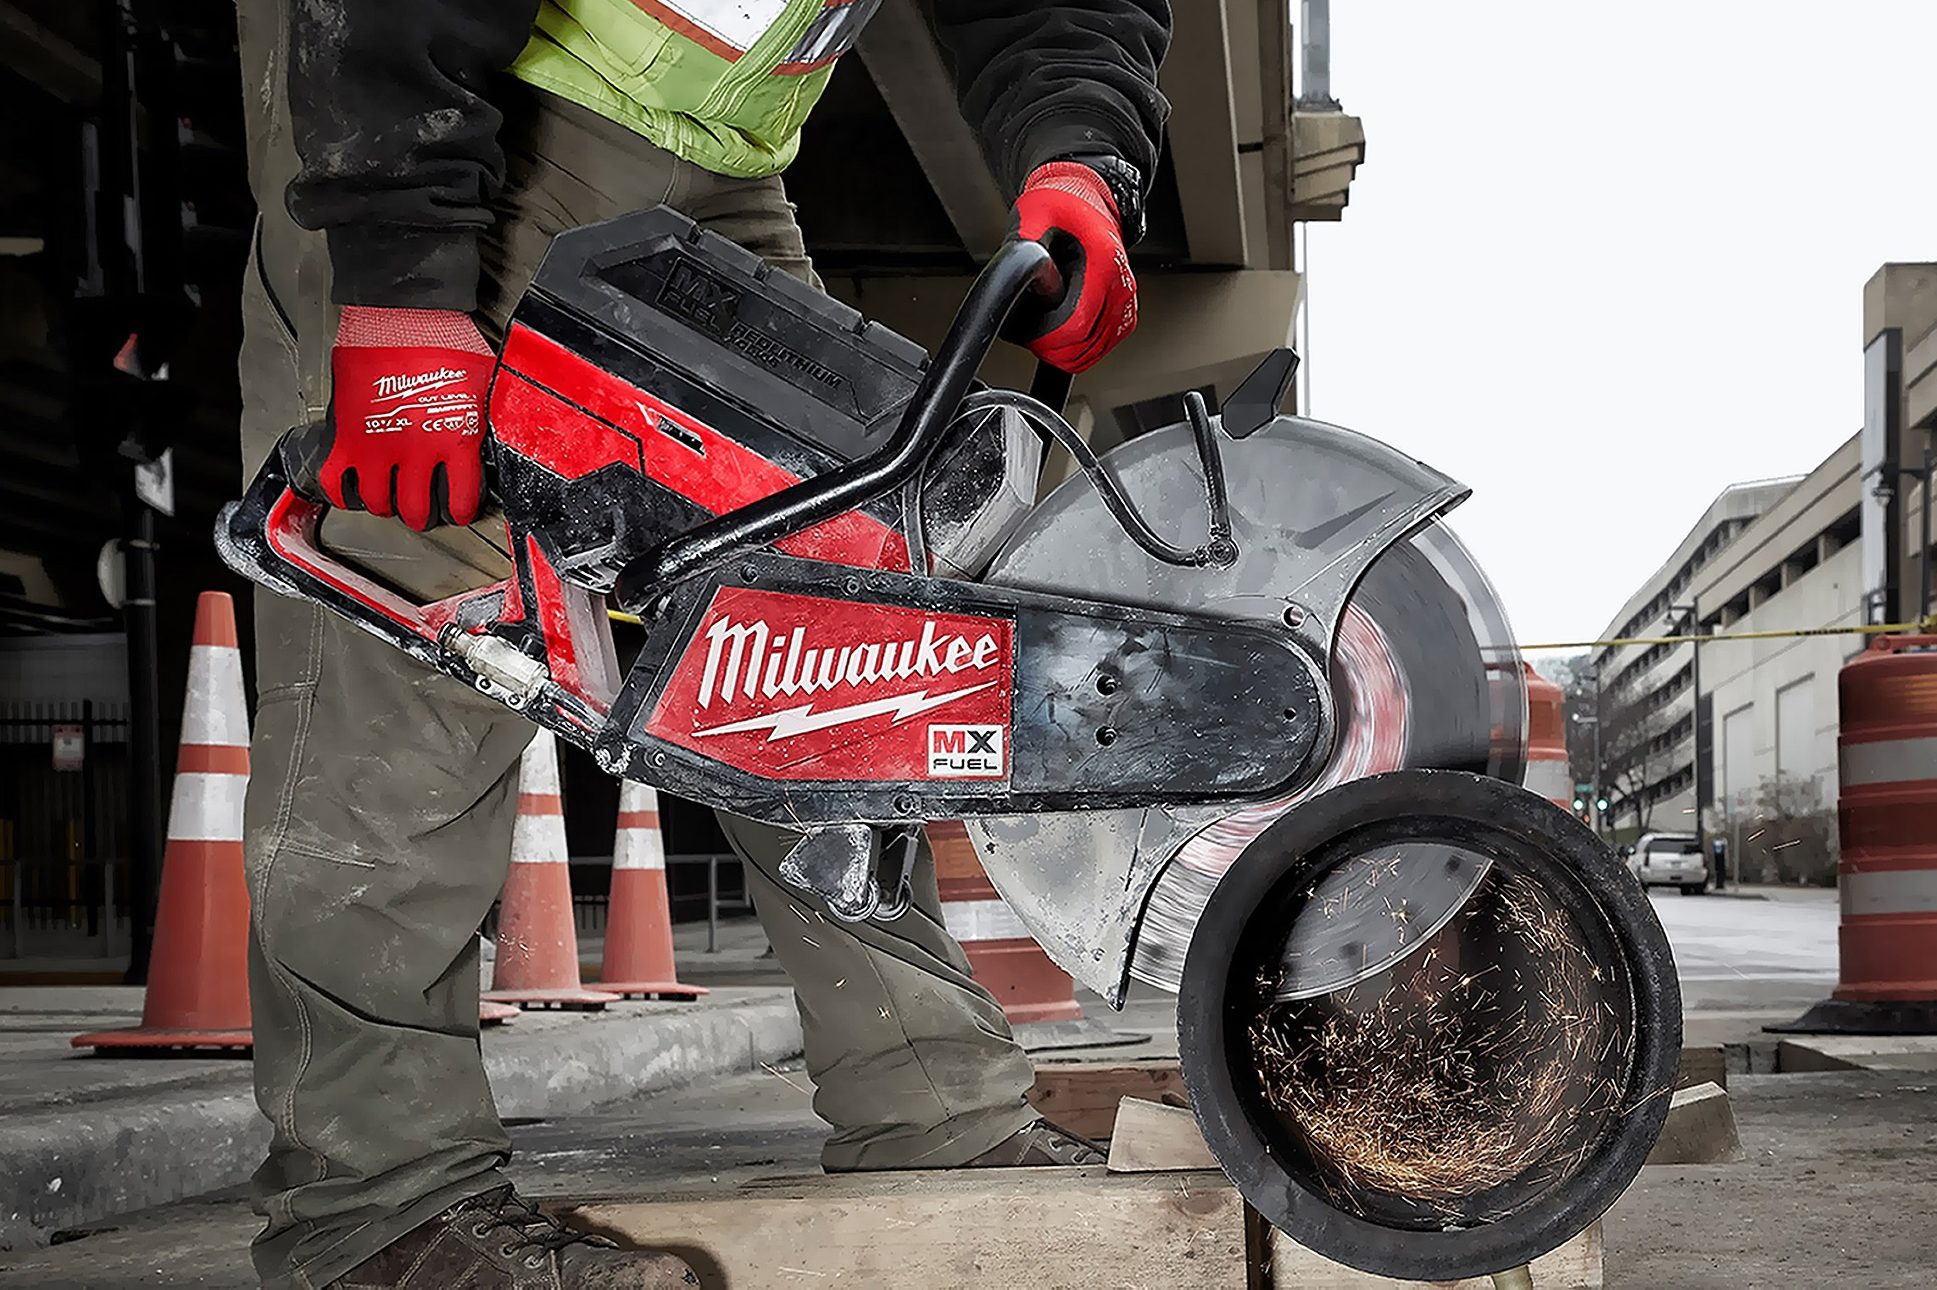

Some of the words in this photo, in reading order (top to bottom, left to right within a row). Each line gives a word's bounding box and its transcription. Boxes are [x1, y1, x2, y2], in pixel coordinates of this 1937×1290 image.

[671, 265, 739, 309] MX
[663, 291, 722, 332] FUEL
[372, 367, 467, 397] Milwaukee
[698, 614, 999, 710] Milwaukee
[932, 730, 996, 754] MX
[933, 758, 998, 770] FUEL
